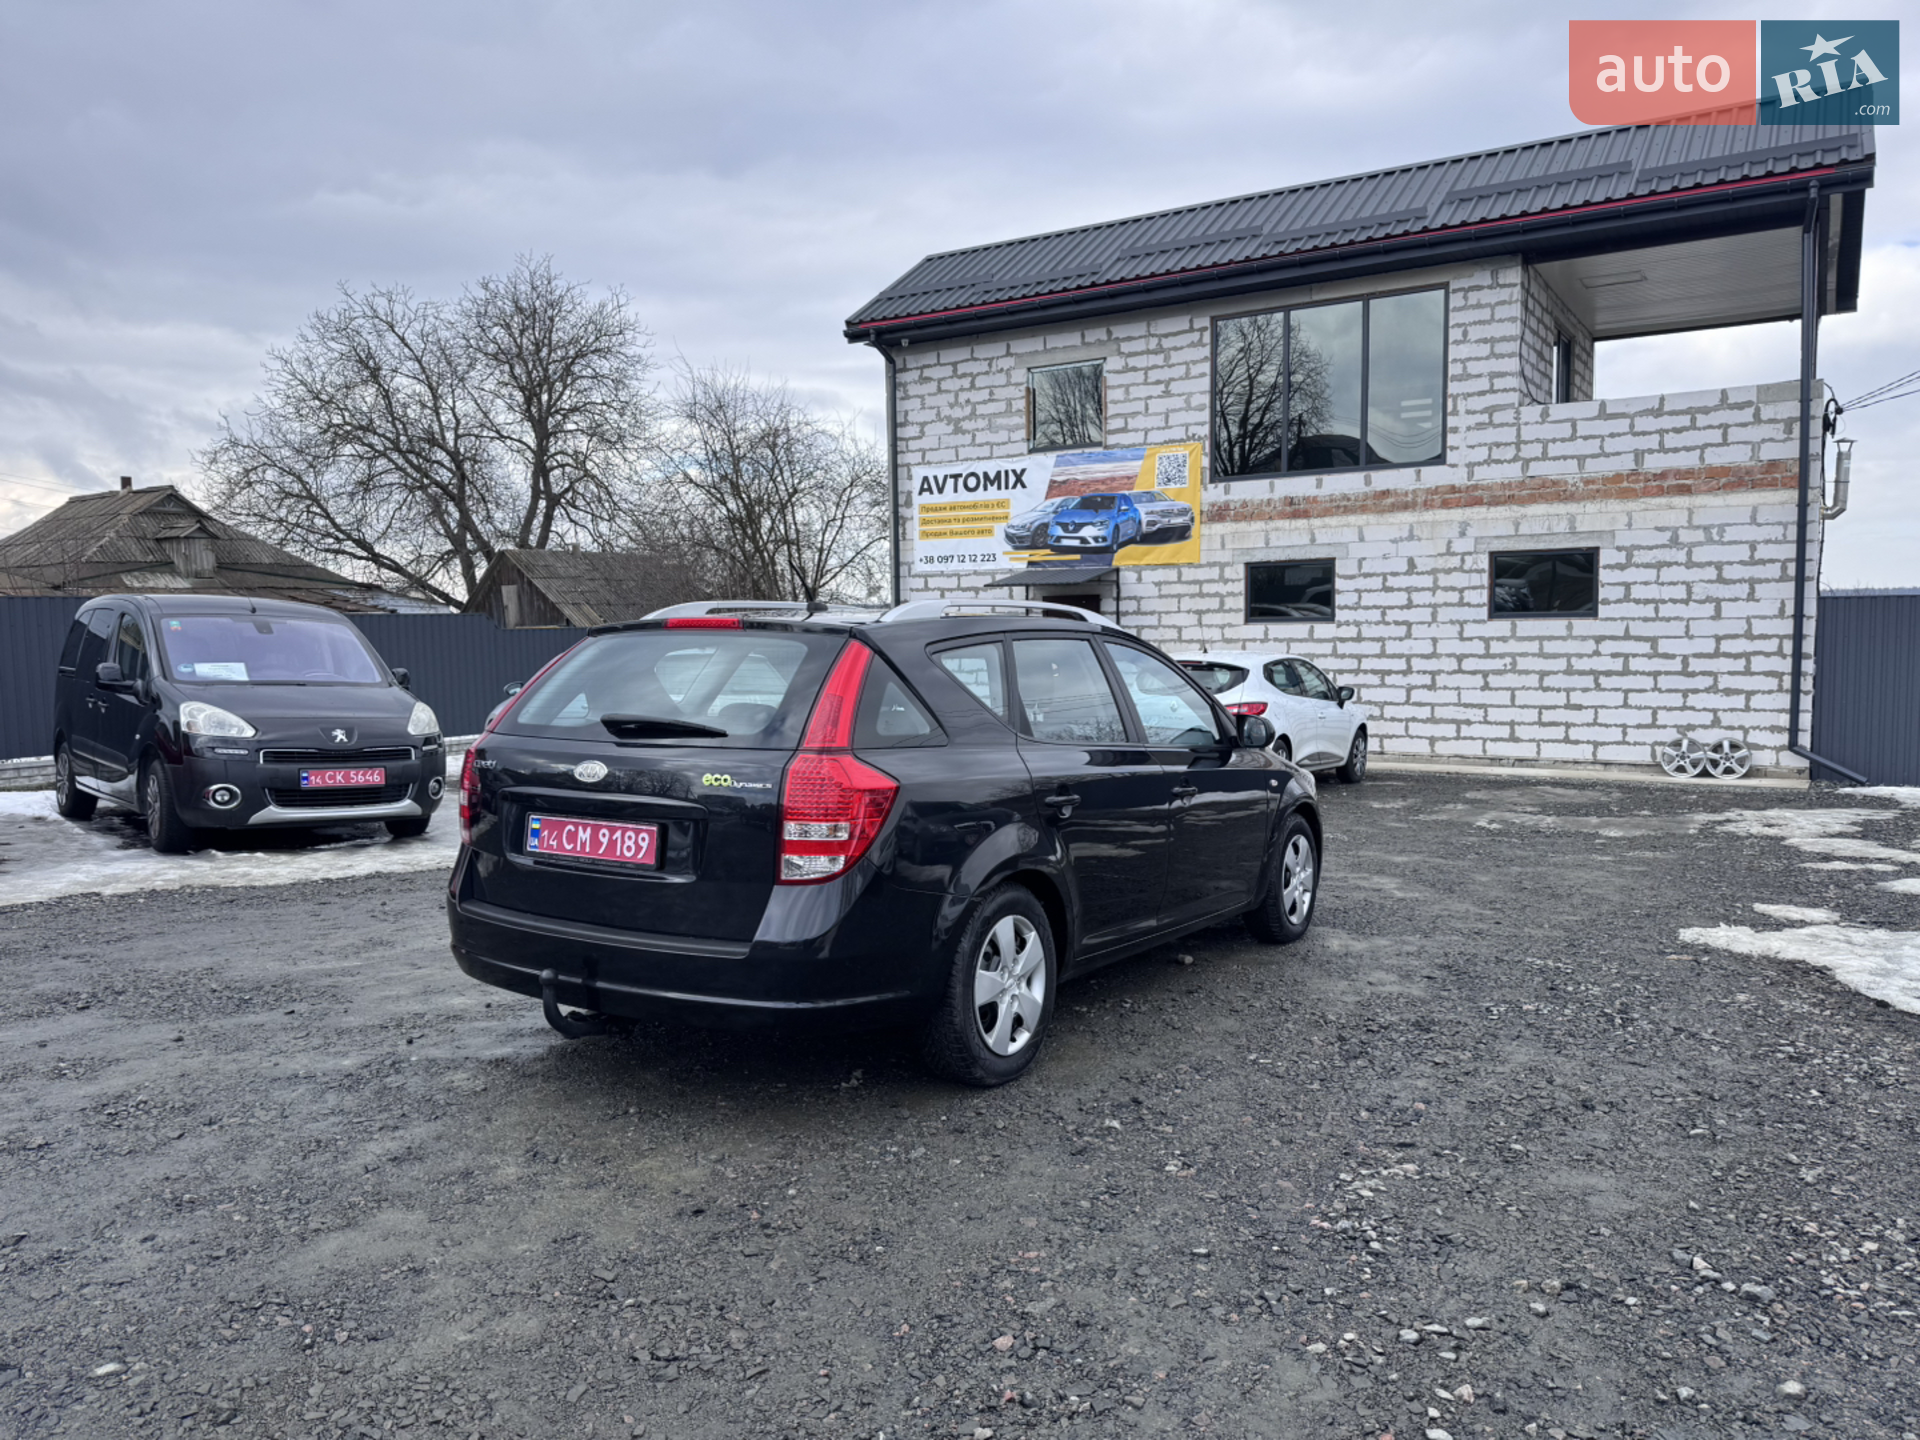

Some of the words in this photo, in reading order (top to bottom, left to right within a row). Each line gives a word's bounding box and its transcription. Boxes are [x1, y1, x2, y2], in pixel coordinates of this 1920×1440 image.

[918, 468, 1028, 496] AVTOMIX
[920, 505, 947, 513] Продаж
[921, 517, 952, 525] Доставка
[919, 555, 935, 565] +38
[936, 554, 954, 564] 097
[957, 554, 966, 563] 12
[968, 553, 978, 563] 12
[980, 552, 997, 562] 223
[310, 776, 322, 785] 14
[325, 771, 345, 784] CK
[350, 770, 381, 783] 5646
[541, 829, 558, 850] 14
[562, 824, 592, 853] CM
[597, 828, 650, 859] 9189
